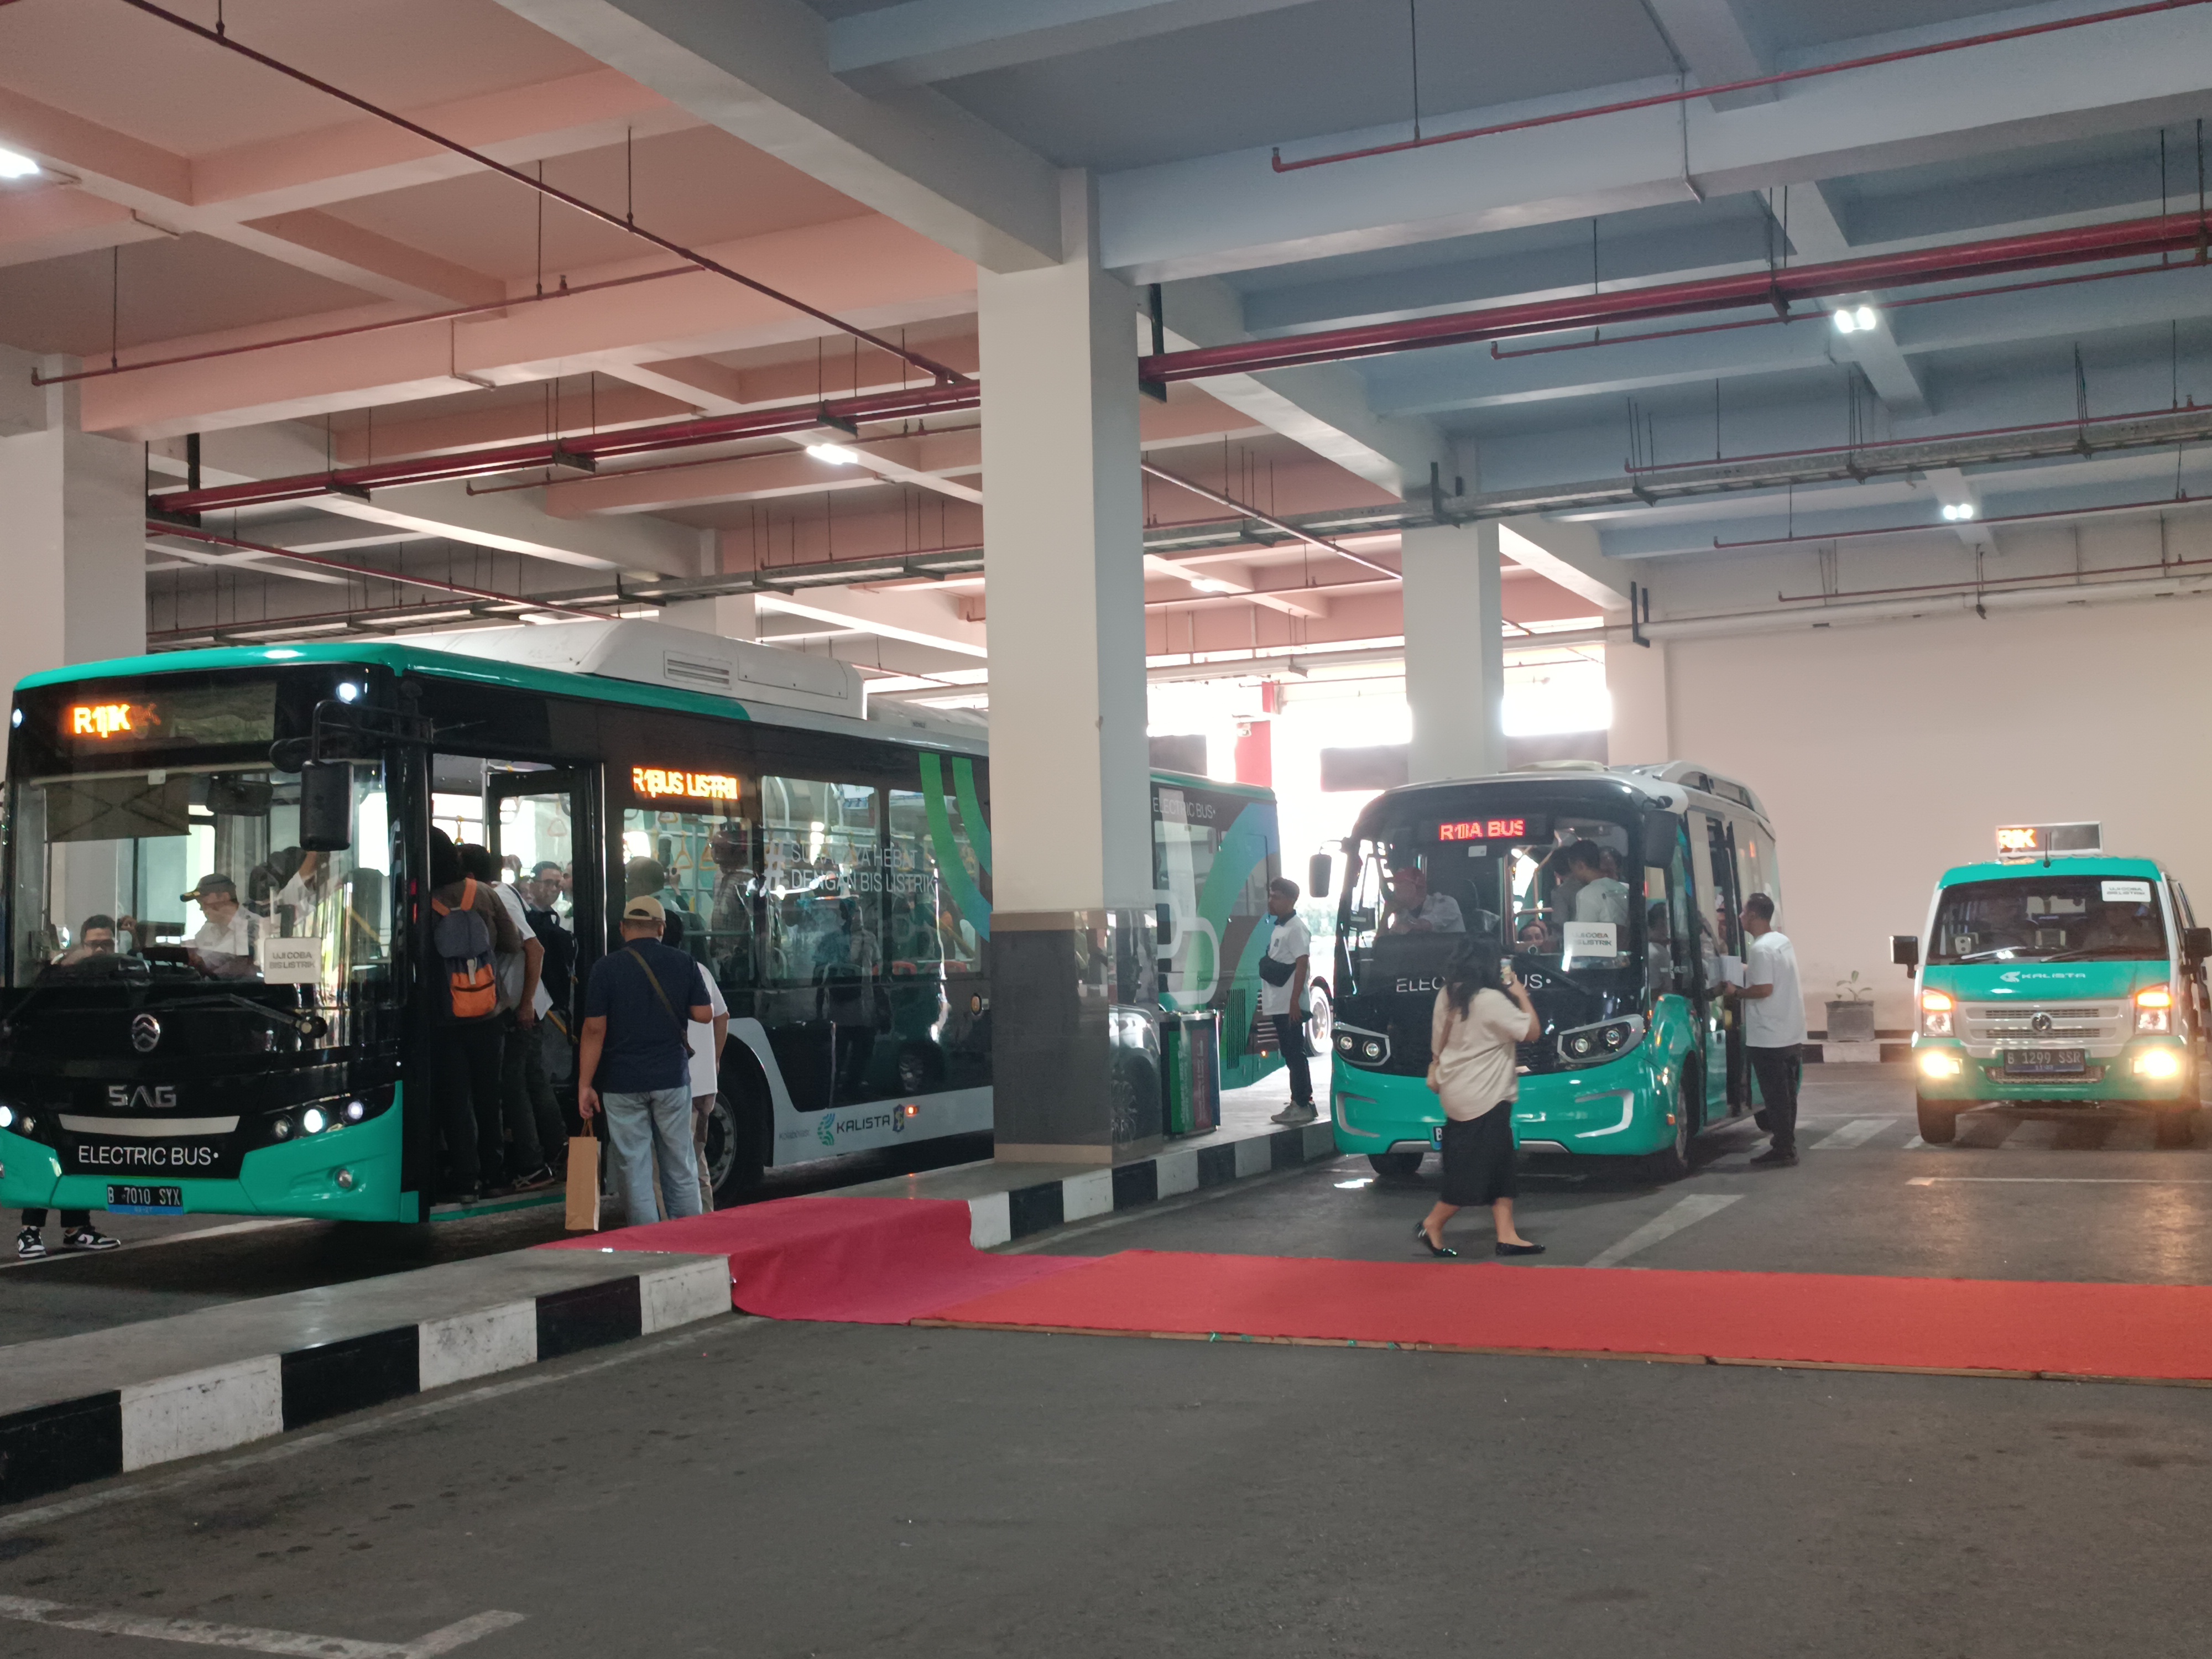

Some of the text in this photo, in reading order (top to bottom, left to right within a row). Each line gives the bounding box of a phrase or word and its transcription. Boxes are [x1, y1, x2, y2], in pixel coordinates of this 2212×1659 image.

[1152, 797, 1194, 817] ELECTRIC
[1488, 820, 1524, 837] BUS
[874, 849, 917, 869] HEBAT
[860, 873, 883, 893] BIS
[886, 874, 936, 894] LISTRIK
[1396, 976, 1446, 992] ELEC
[2007, 1051, 2081, 1064] B 1299 SSR
[108, 1085, 176, 1107] SAG
[837, 1114, 891, 1134] KALISTA
[1436, 1128, 1442, 1141] B
[79, 1145, 166, 1165] ELECTRIC
[107, 1187, 180, 1206] B 7010 SYX
